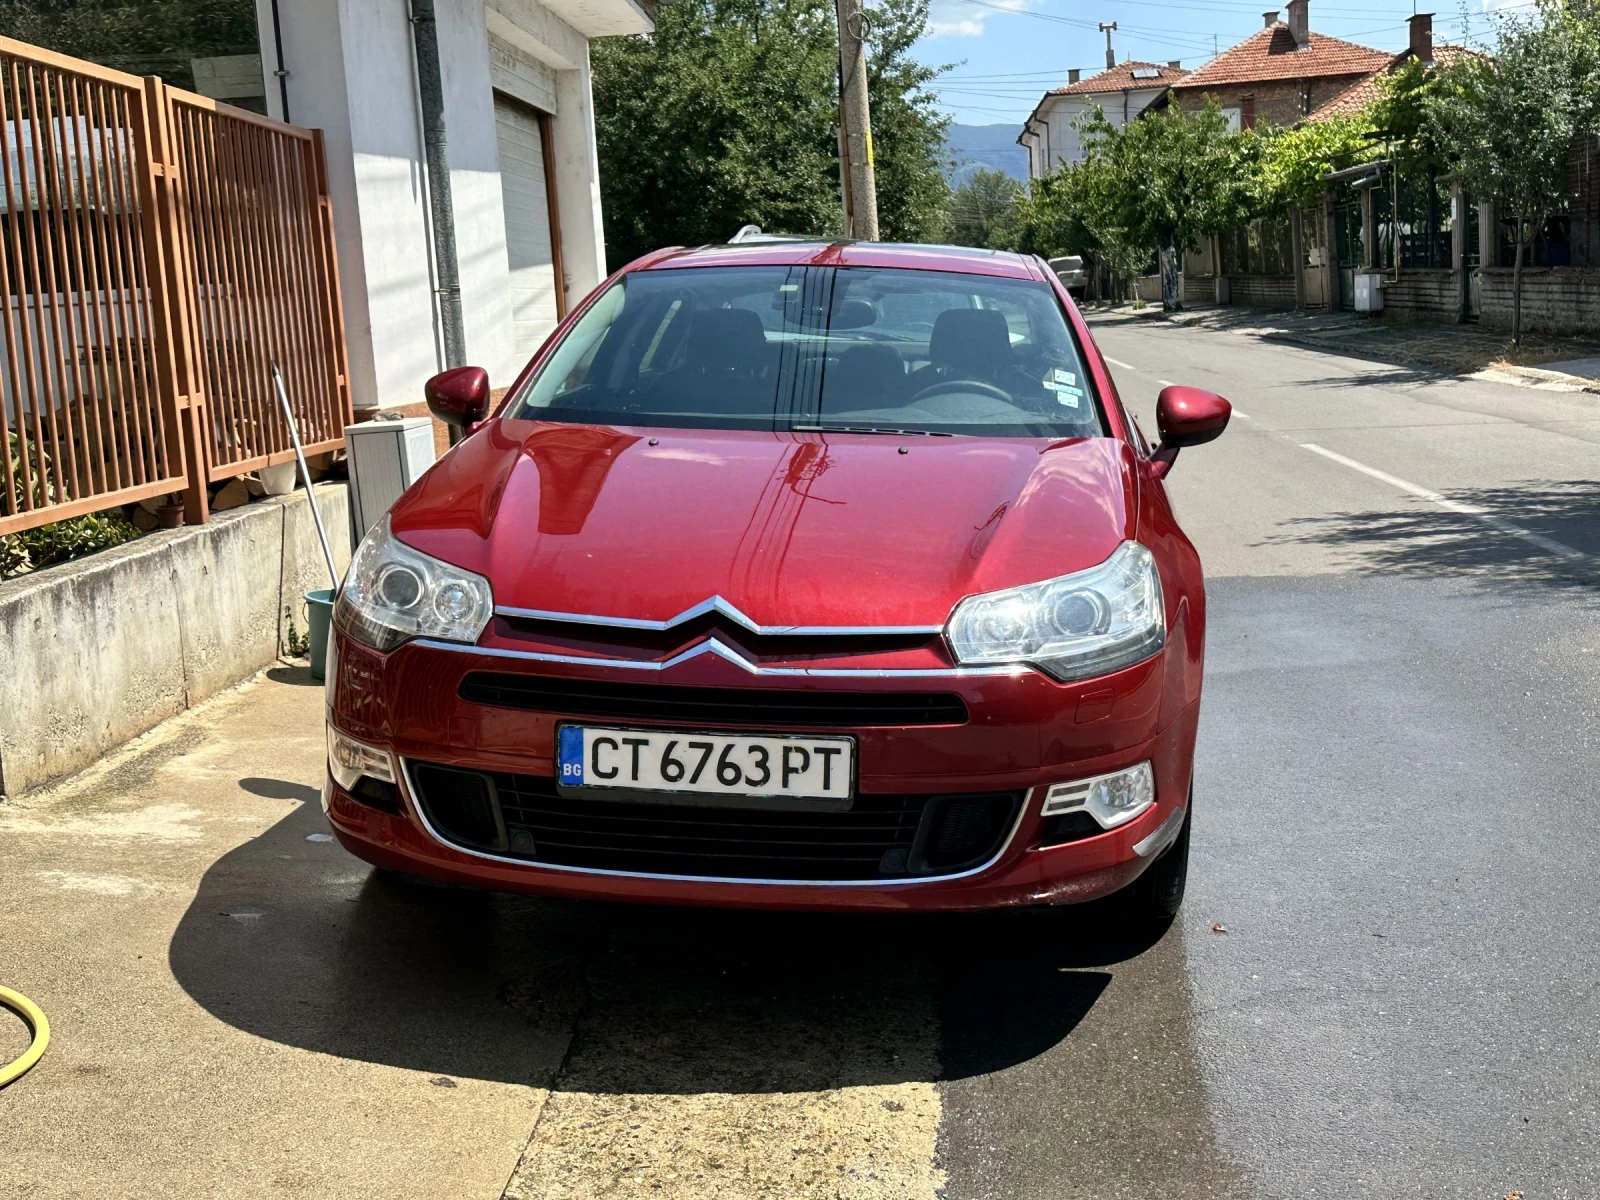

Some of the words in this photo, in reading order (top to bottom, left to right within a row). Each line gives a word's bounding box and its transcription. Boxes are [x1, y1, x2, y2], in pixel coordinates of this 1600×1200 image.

[563, 763, 582, 776] BG
[591, 737, 649, 780] CT
[660, 740, 771, 787] 6763
[782, 745, 842, 790] PT
